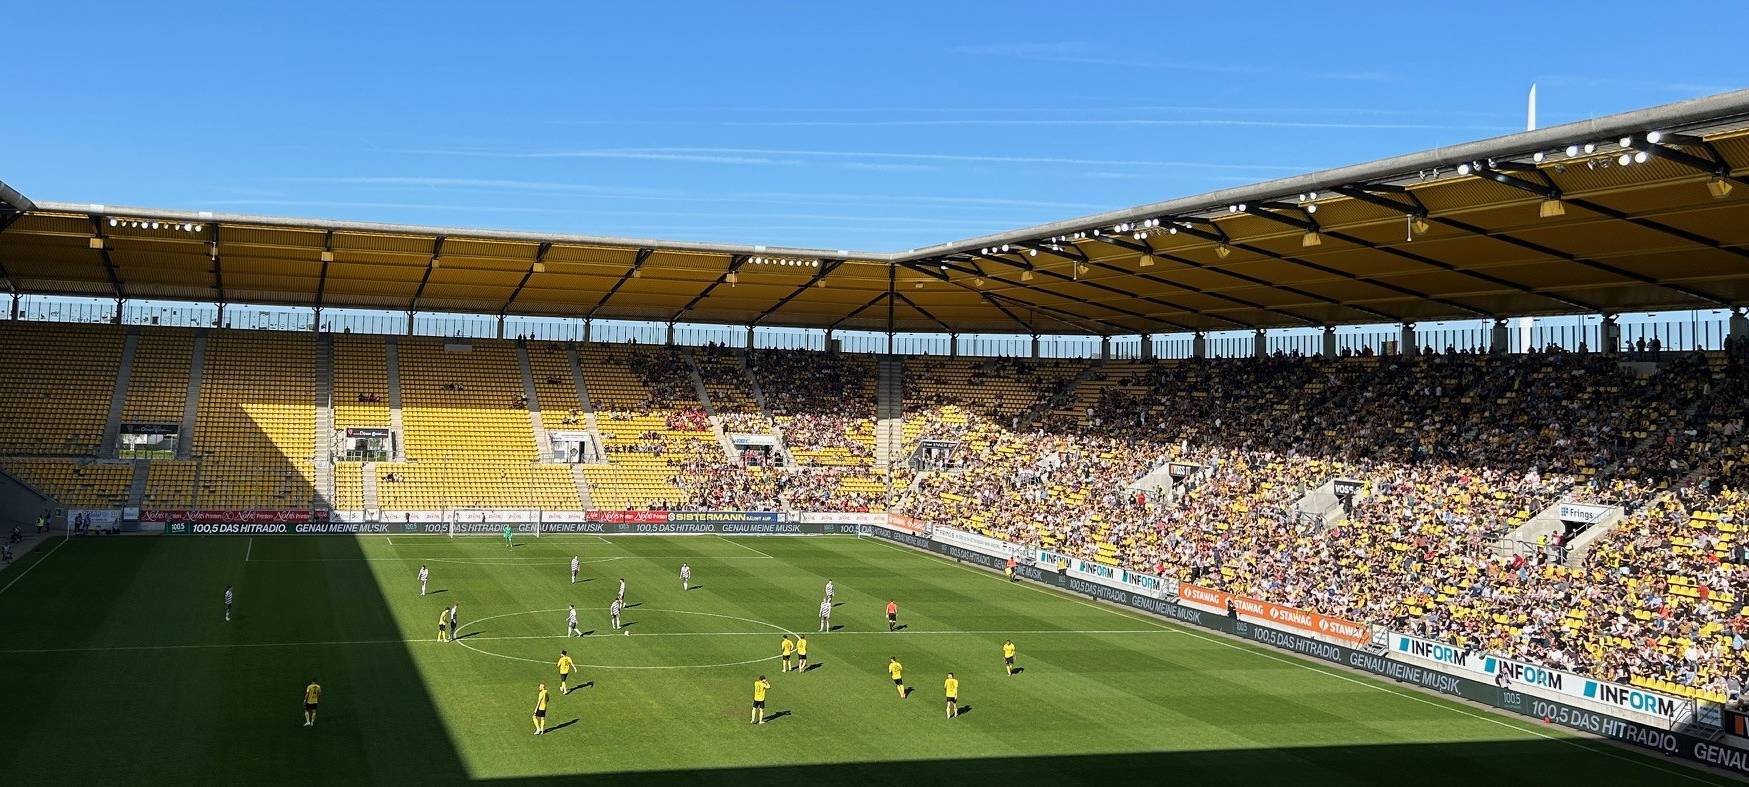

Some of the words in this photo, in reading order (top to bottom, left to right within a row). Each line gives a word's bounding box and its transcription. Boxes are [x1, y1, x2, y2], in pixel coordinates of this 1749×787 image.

[676, 513, 746, 521] SISTERMANN
[1570, 508, 1593, 520] Frings
[193, 523, 219, 534] 100,5
[219, 523, 240, 532] DAS
[240, 523, 287, 533] HITRADIO.
[296, 524, 328, 533] GENAU
[329, 524, 358, 532] MEINE
[424, 524, 449, 533] 100,5
[549, 524, 577, 532] MEINE
[636, 524, 658, 533] 100,5
[658, 524, 675, 532] DAS
[675, 524, 715, 532] HITRADIO.
[722, 524, 750, 532] GENAU
[750, 524, 775, 532] MEINE
[1085, 562, 1114, 579] INFORM
[1129, 573, 1160, 590] INFORM
[1069, 579, 1085, 593] 100,5
[1085, 583, 1098, 596] DAS
[1098, 586, 1127, 604] HITRADIO.
[1131, 596, 1155, 611] GENAU
[1155, 601, 1178, 617] MEINE
[1192, 589, 1219, 604] STAWAG
[1234, 600, 1264, 615] STAWAG
[1279, 611, 1313, 627] STAWAG
[1254, 626, 1276, 643] 100,5
[1276, 634, 1295, 649] DAS
[1295, 637, 1342, 661] HITRADIO.
[1350, 652, 1384, 673] GENAU
[1386, 662, 1420, 683] MEINE
[1422, 673, 1462, 695] MUSIK.
[1411, 638, 1467, 667] INFORM
[1600, 685, 1675, 718] INFORM
[1531, 700, 1569, 723] 100,5
[1571, 710, 1600, 731] DAS
[1601, 718, 1679, 753] HITRADIO.
